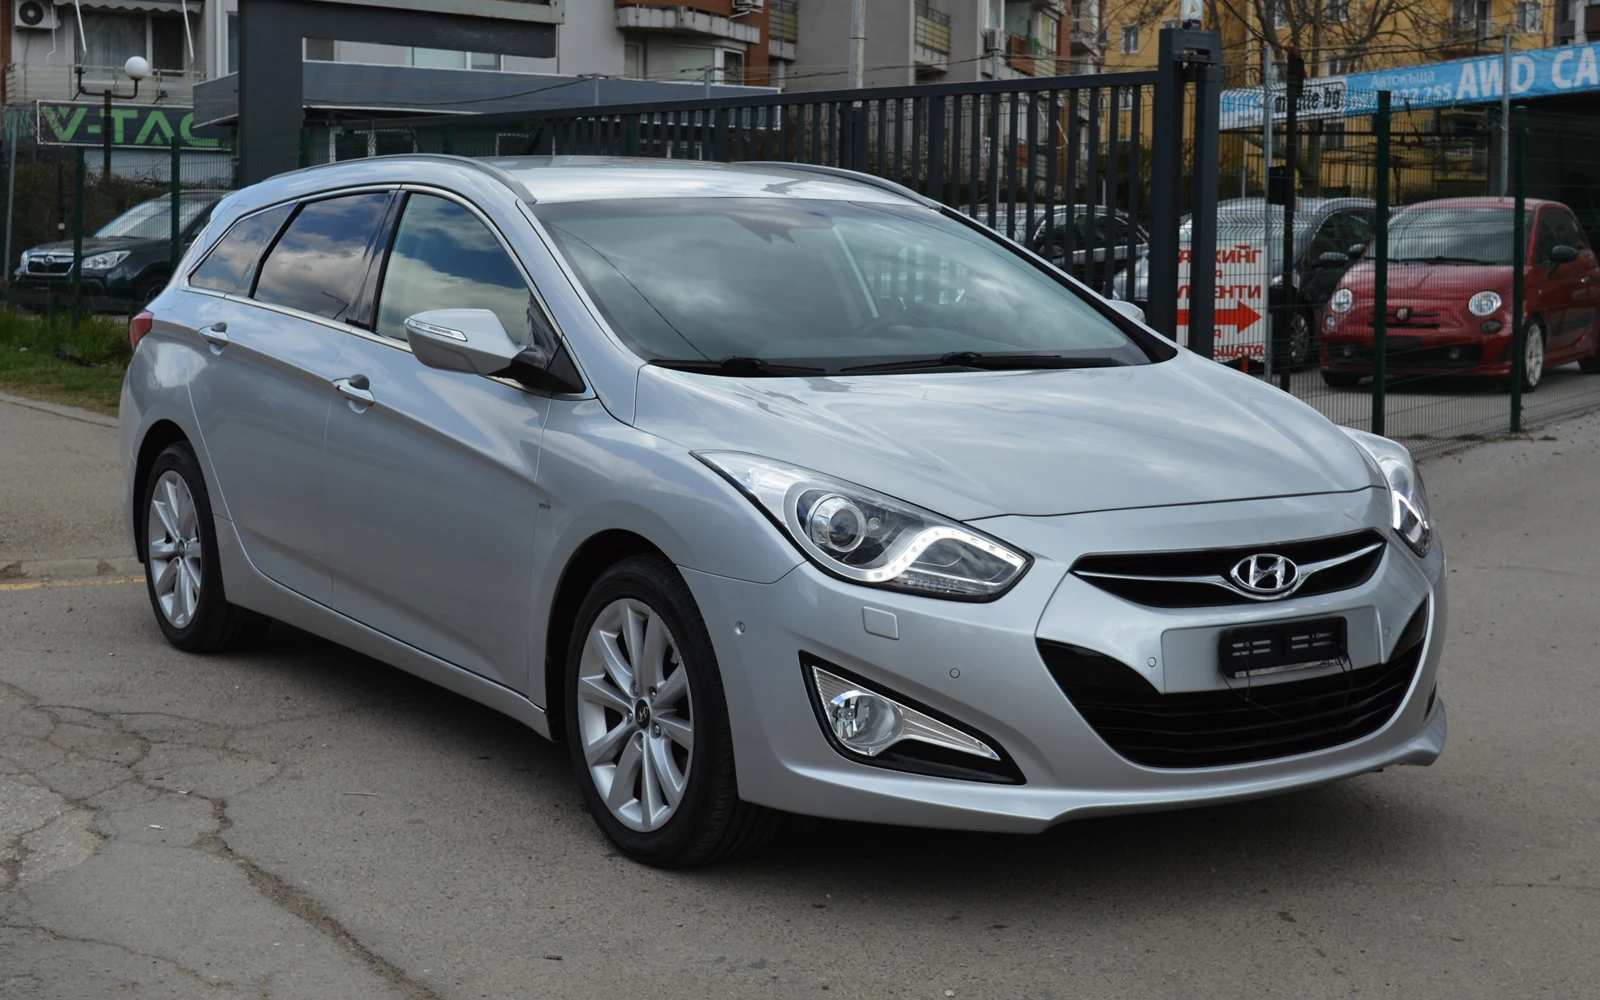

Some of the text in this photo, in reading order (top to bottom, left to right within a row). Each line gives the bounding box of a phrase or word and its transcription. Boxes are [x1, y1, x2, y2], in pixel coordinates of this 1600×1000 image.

[1370, 71, 1435, 89] Автокъща
[1456, 55, 1535, 99] AWD
[42, 105, 219, 147] V-TAC
